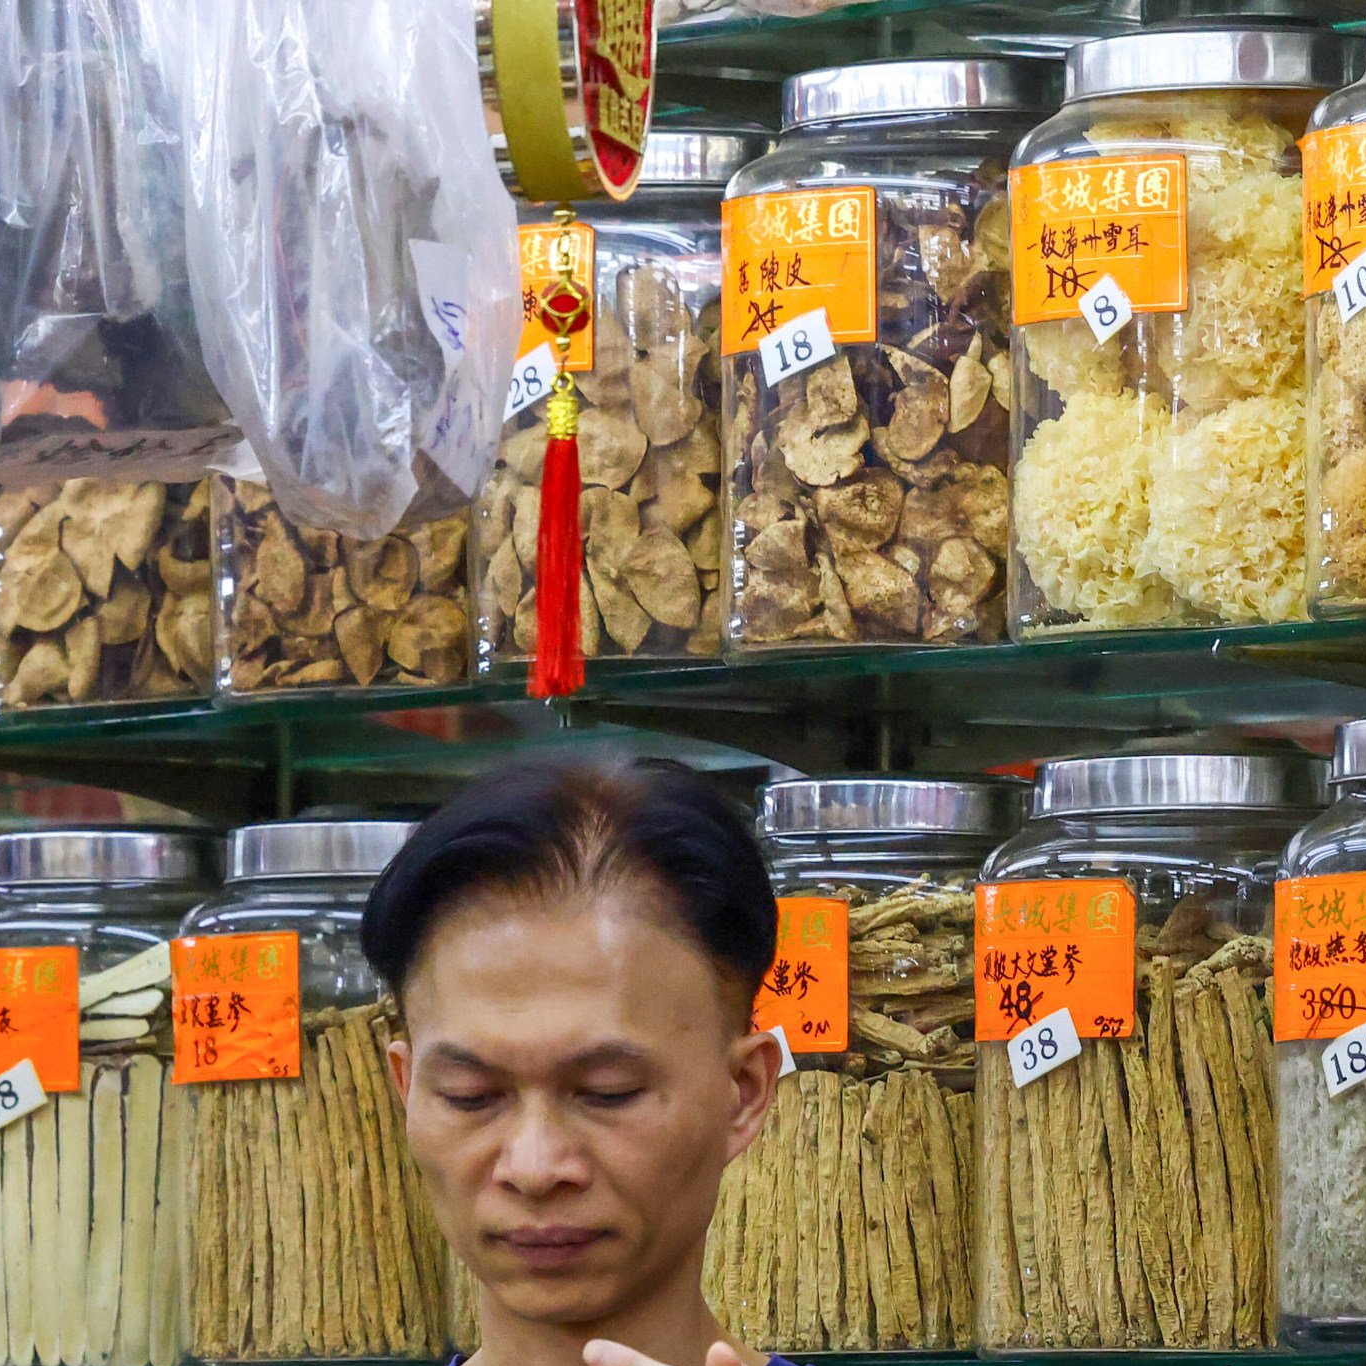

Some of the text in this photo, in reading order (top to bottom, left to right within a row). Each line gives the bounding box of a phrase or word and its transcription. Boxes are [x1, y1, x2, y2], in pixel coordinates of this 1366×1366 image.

[1035, 166, 1171, 215] 長城集團
[1093, 294, 1119, 327] 8
[774, 329, 814, 372] 18
[508, 364, 543, 410] 28
[194, 1036, 218, 1068] 18
[1020, 1026, 1059, 1071] 38
